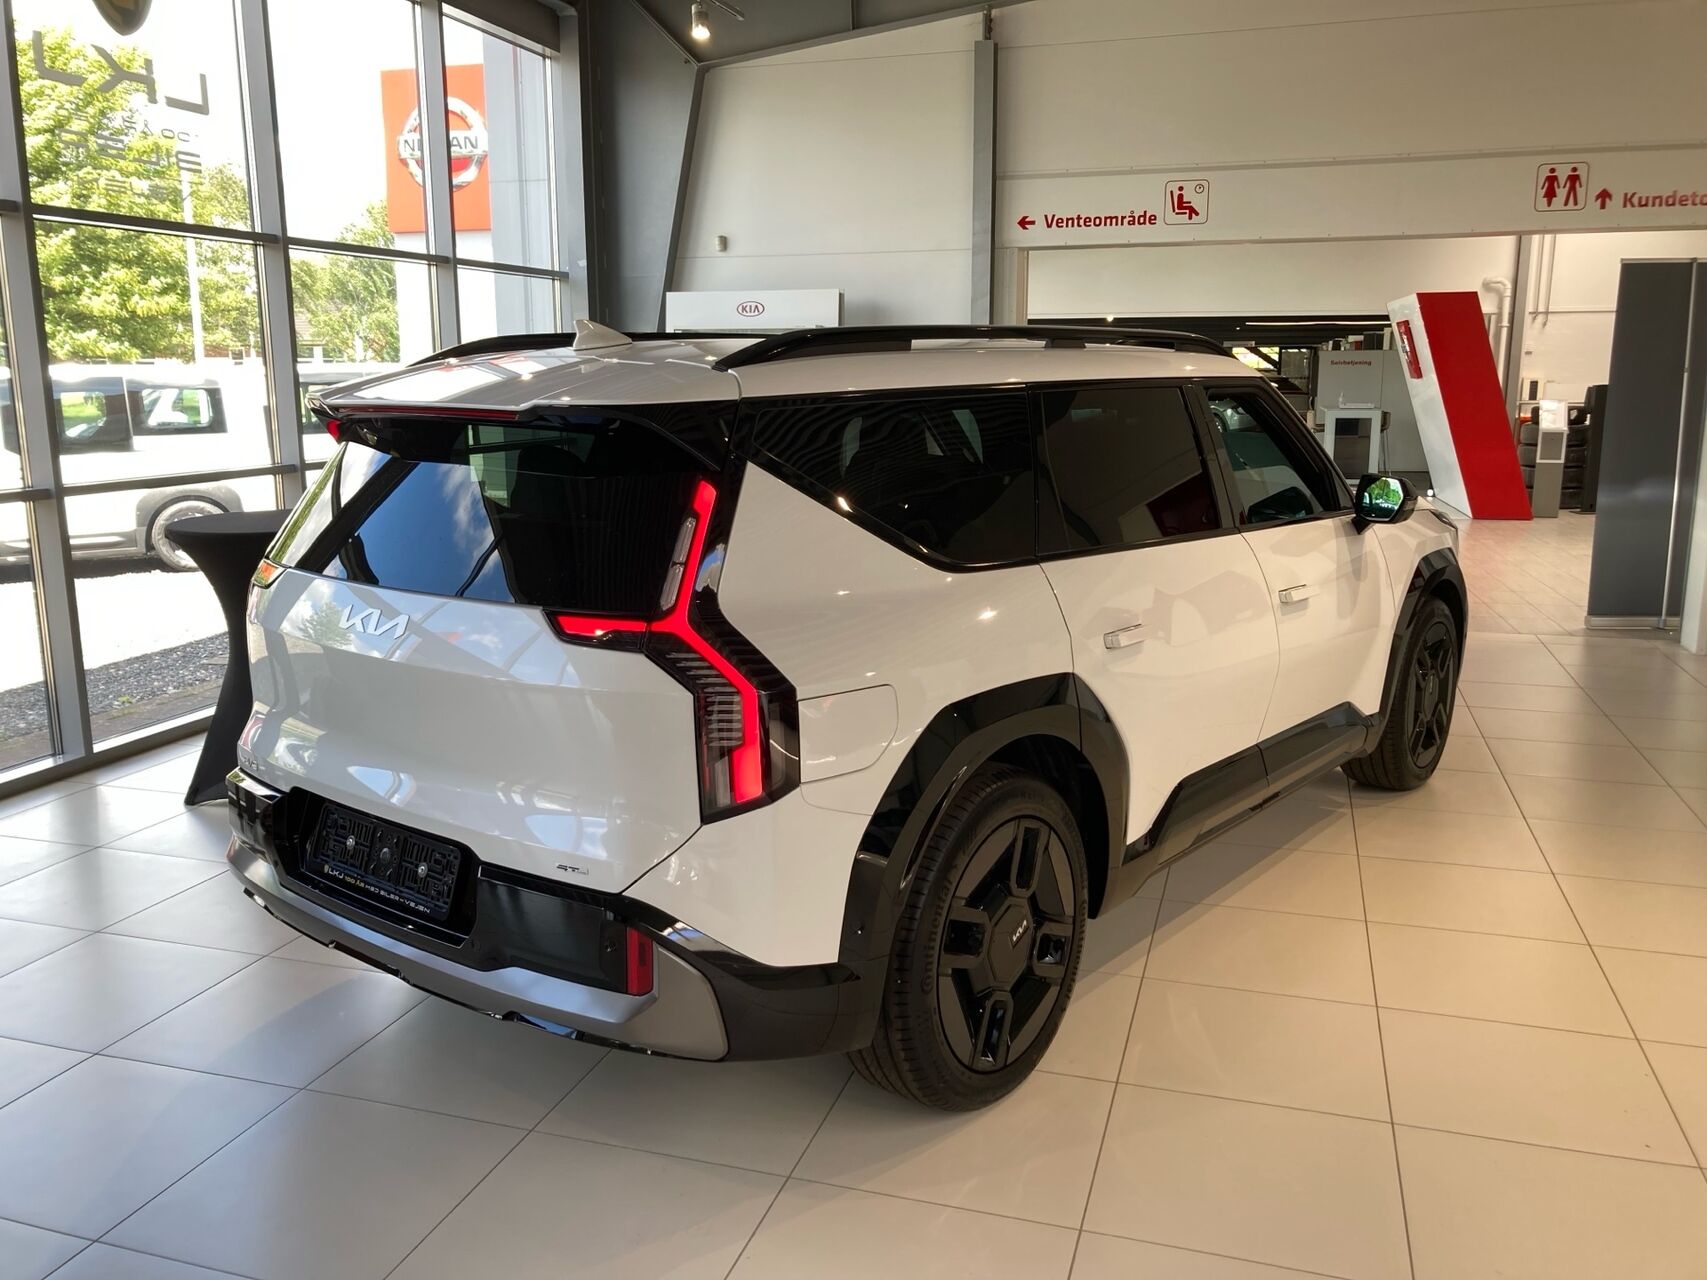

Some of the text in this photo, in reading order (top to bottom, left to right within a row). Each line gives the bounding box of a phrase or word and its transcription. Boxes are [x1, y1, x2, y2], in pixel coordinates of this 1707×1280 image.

[404, 136, 479, 153] NIAN
[1044, 210, 1158, 229] Venteområde
[741, 304, 761, 314] KIA
[338, 603, 411, 640] KIA
